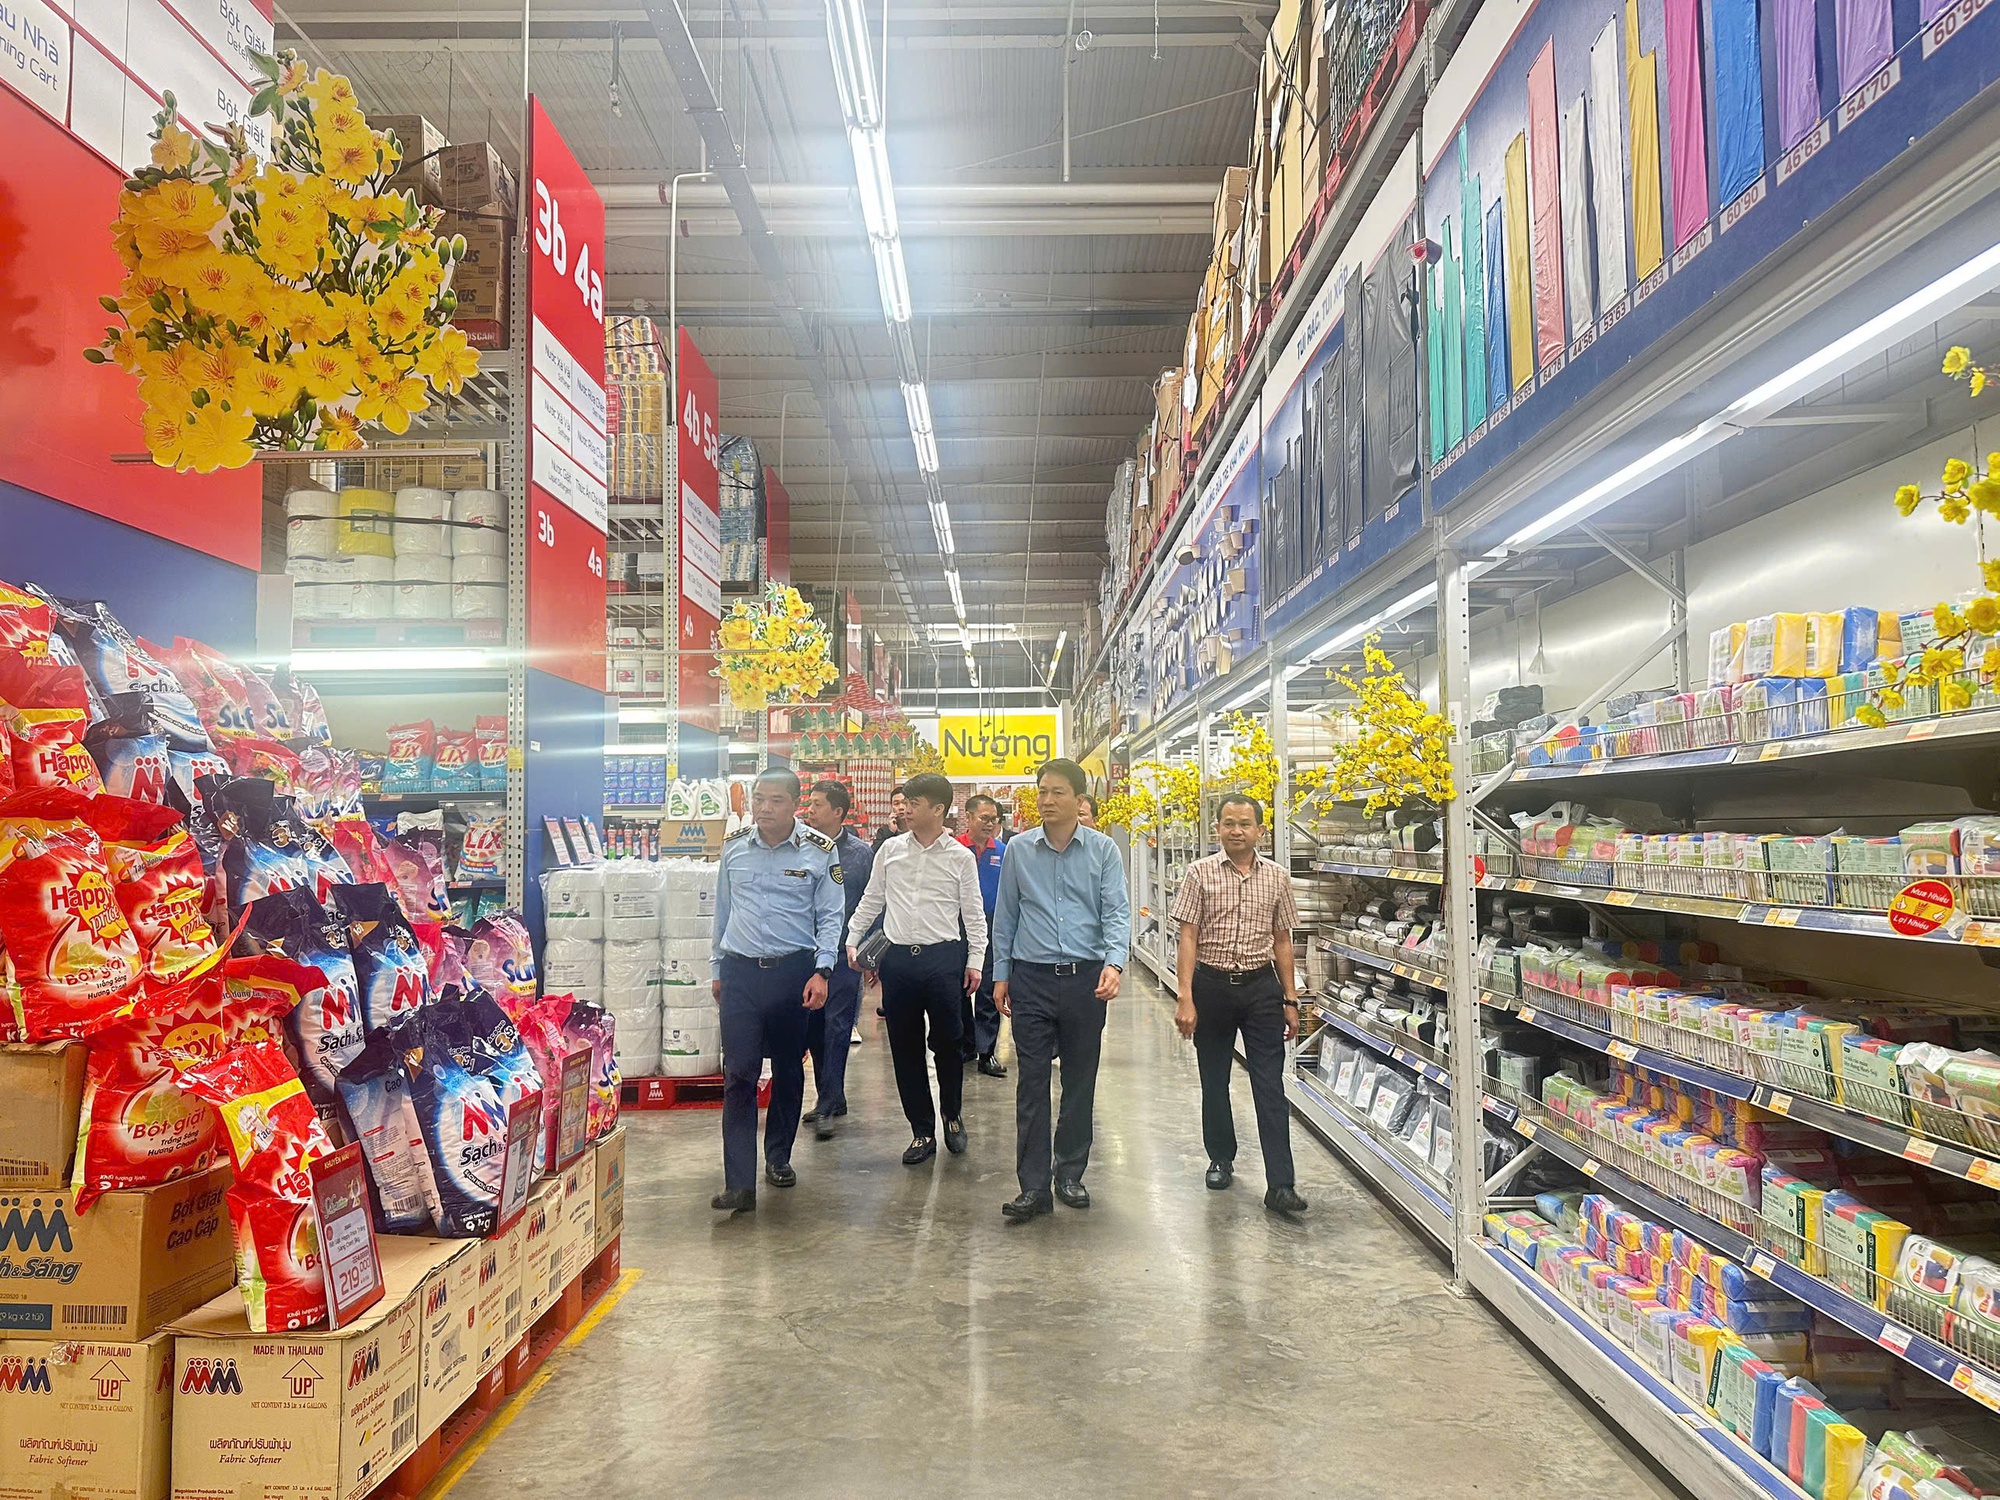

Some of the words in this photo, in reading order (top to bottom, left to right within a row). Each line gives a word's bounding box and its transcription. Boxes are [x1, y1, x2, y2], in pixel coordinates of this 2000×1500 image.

[219, 0, 240, 33] Bột
[24, 16, 58, 66] Nhà
[30, 58, 58, 91] Cart
[218, 88, 238, 123] Bột
[243, 114, 265, 149] Giặt
[535, 178, 567, 276] 3b
[574, 243, 603, 324] 4a
[684, 390, 700, 447] 4b
[704, 412, 718, 471] 5a
[538, 511, 555, 548] 3b
[587, 547, 603, 578] 4a
[437, 748, 468, 763] LIX
[944, 728, 1051, 764] Nướng
[39, 751, 93, 775] Happy
[465, 827, 502, 849] LIX
[51, 884, 115, 912] Happy
[1911, 887, 1927, 898] Mua
[1928, 891, 1950, 904] Nhiều
[1893, 914, 1906, 925] Lợi
[1909, 920, 1930, 931] Nhiều
[385, 1079, 402, 1093] Cao
[132, 1119, 171, 1142] Bột
[173, 1109, 207, 1139] giặt
[170, 1200, 194, 1225] Bột
[166, 1229, 192, 1250] Cao
[194, 1211, 219, 1239] Cấp
[339, 1266, 360, 1296] 219
[8, 1312, 18, 1321] kg
[25, 1312, 31, 1320] 2
[87, 1345, 94, 1356] IN
[97, 1346, 131, 1357] THAILAND
[253, 1345, 274, 1356] MADE
[277, 1345, 285, 1355] IN
[288, 1346, 324, 1356] THAILAND
[101, 1379, 119, 1397] UP
[293, 1377, 312, 1395] UP
[29, 1454, 54, 1464] Fabric
[57, 1455, 89, 1467] Softener
[219, 1454, 246, 1464] Fabric
[249, 1454, 282, 1466] Softener
